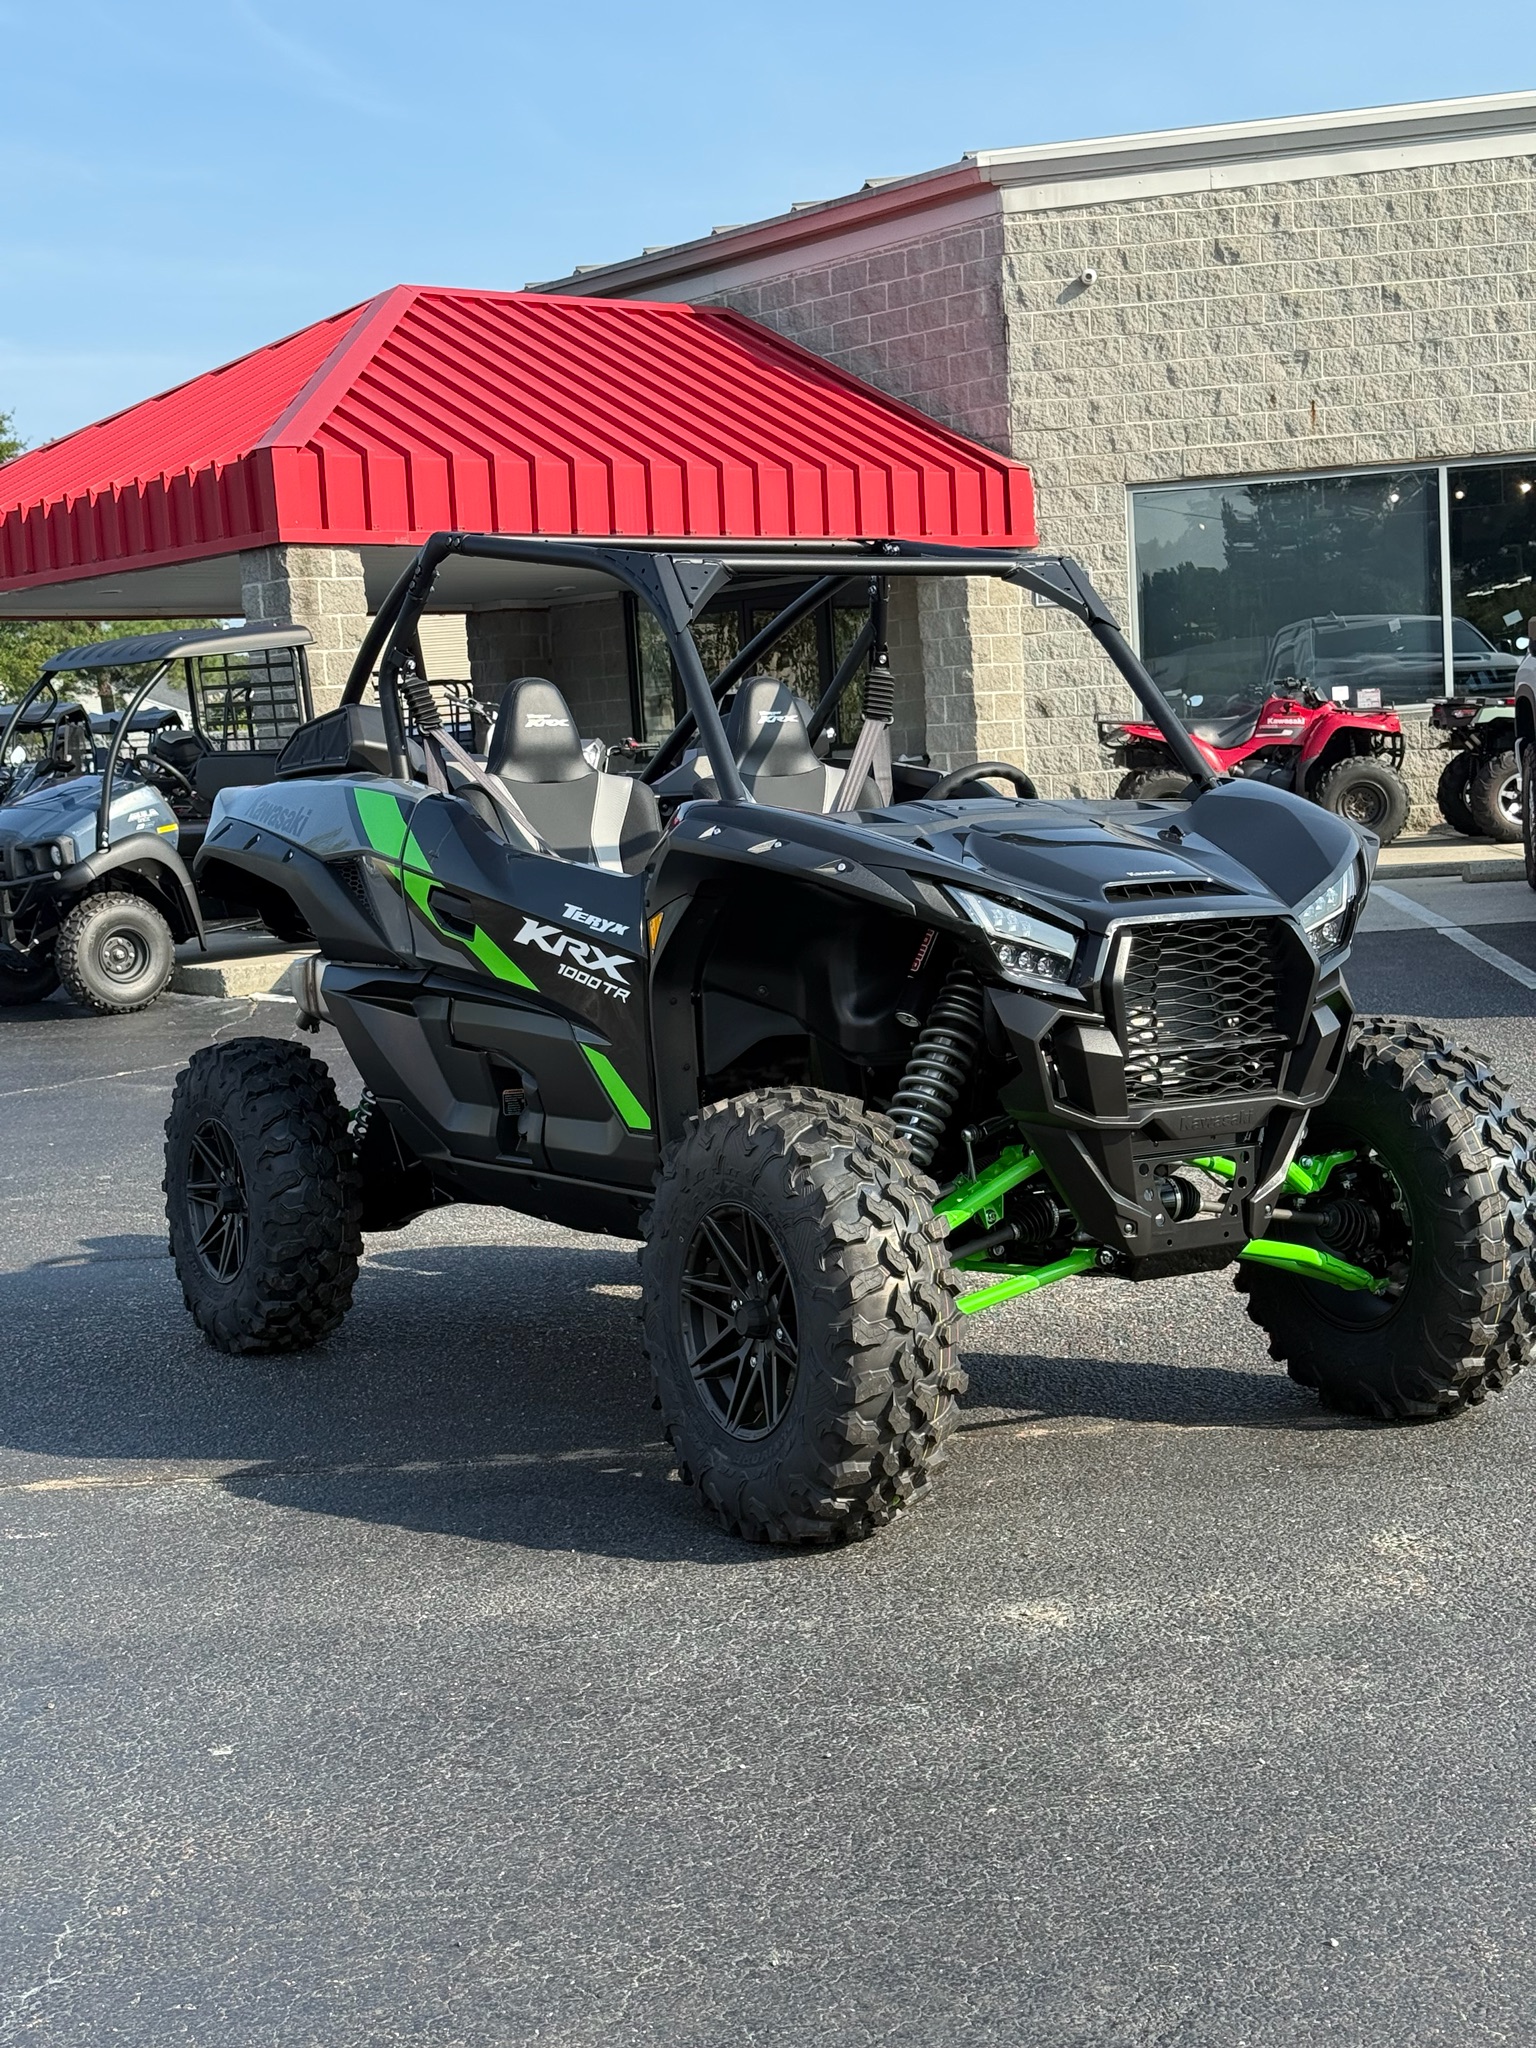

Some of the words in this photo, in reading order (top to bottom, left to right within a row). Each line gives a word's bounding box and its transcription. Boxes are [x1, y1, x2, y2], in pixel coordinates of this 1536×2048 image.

[525, 718, 570, 727] KRX
[1267, 717, 1305, 725] Kawasaki
[243, 793, 314, 837] Kawasaki
[513, 916, 636, 986] KRX
[1180, 1108, 1254, 1131] Kawasaki
